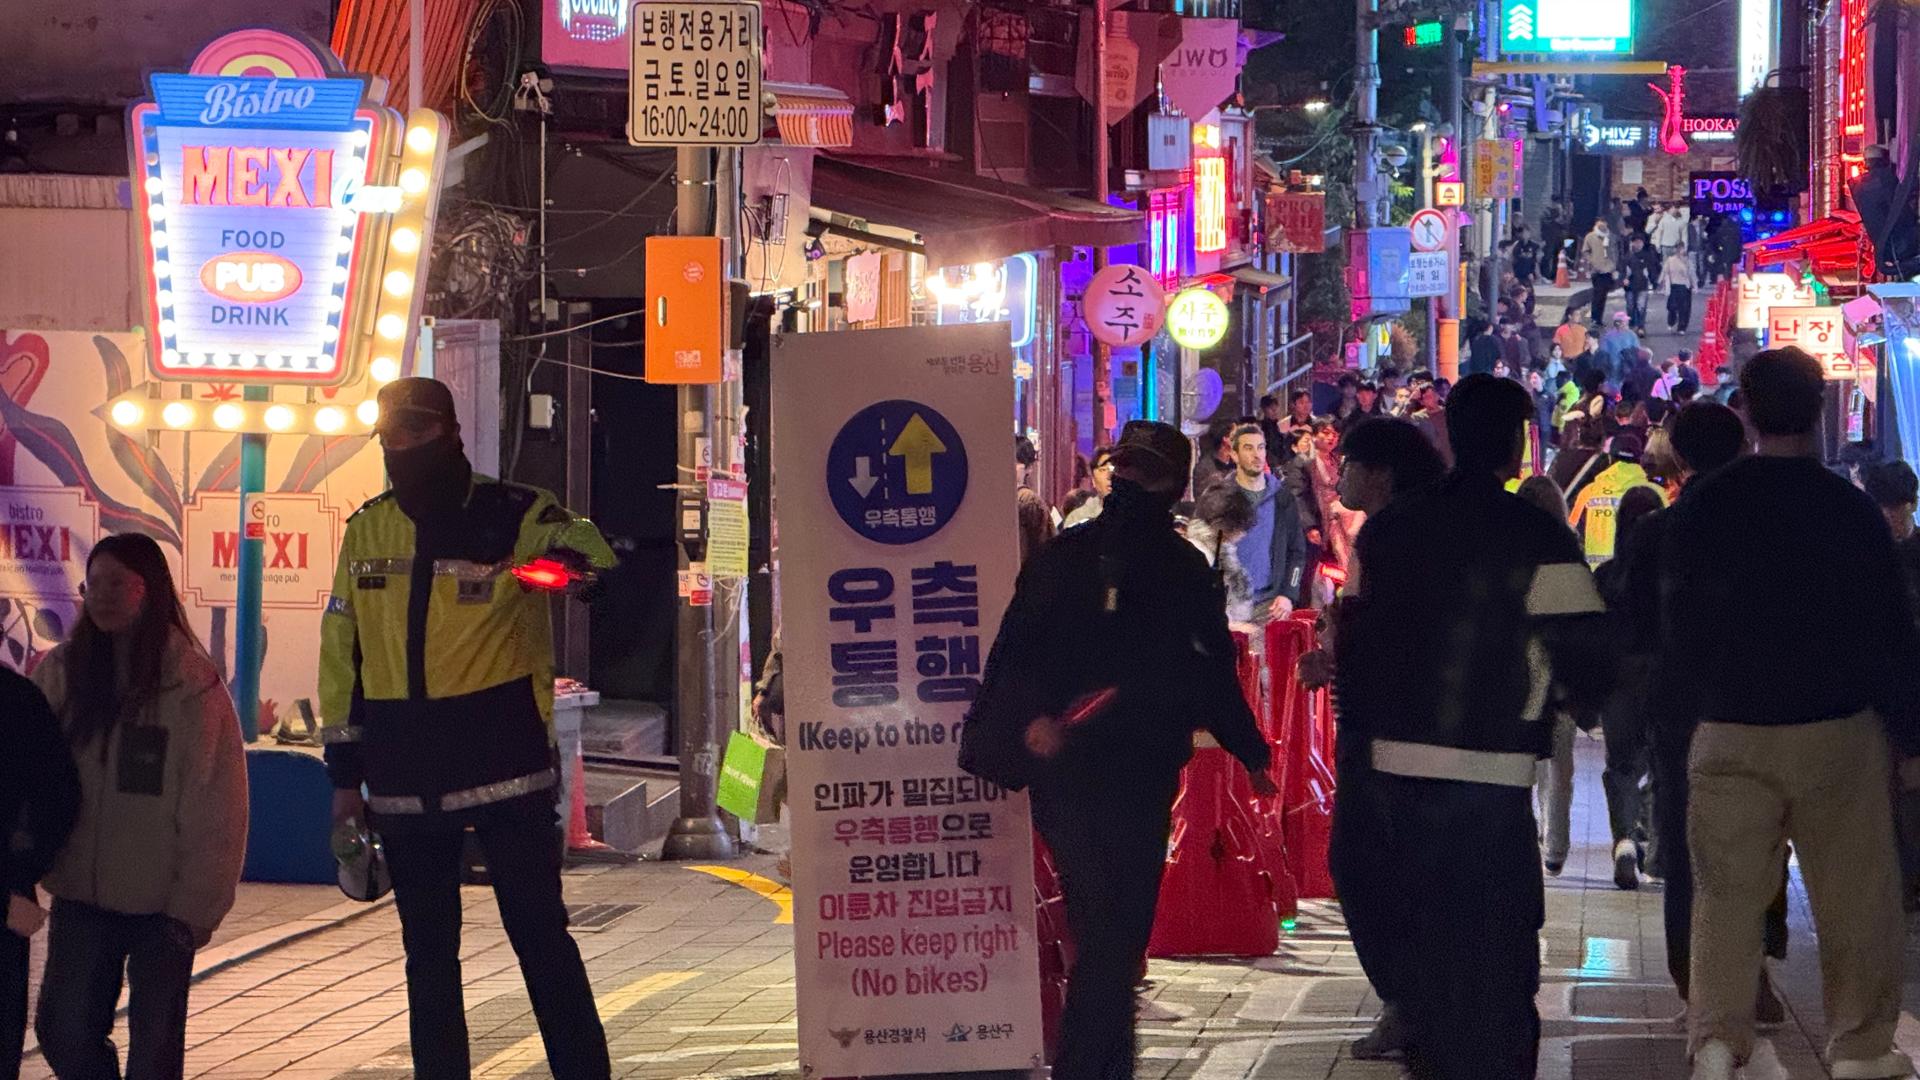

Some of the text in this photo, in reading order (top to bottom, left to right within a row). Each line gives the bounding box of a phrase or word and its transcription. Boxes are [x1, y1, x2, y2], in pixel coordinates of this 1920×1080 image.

[640, 10, 750, 52] 보행전용거리
[644, 59, 750, 100] 금.토.일요일
[199, 78, 316, 125] Bistro
[641, 105, 748, 137] 16:00~24:00
[1601, 127, 1641, 139] HIVE
[181, 145, 335, 208] MEXI
[222, 230, 285, 248] FOOD
[216, 262, 284, 292] PUB
[211, 306, 288, 326] DRINK
[1104, 268, 1144, 342] 소주
[9, 503, 43, 520] bistro
[865, 506, 936, 528] 우측통행
[212, 531, 308, 569] MXI
[827, 560, 979, 633] 우측
[831, 635, 982, 708] 통행
[874, 721, 900, 747] to
[904, 717, 945, 745] the
[814, 781, 894, 811] 인파가
[834, 812, 994, 846] 우측통행으로
[849, 850, 981, 884] 운영합니다
[819, 886, 1012, 920] 이륜차 진입금지
[818, 924, 1019, 960] Please keep right
[852, 963, 988, 997] (No bikes)
[864, 1023, 1014, 1043] 용산경찰서 용산구
